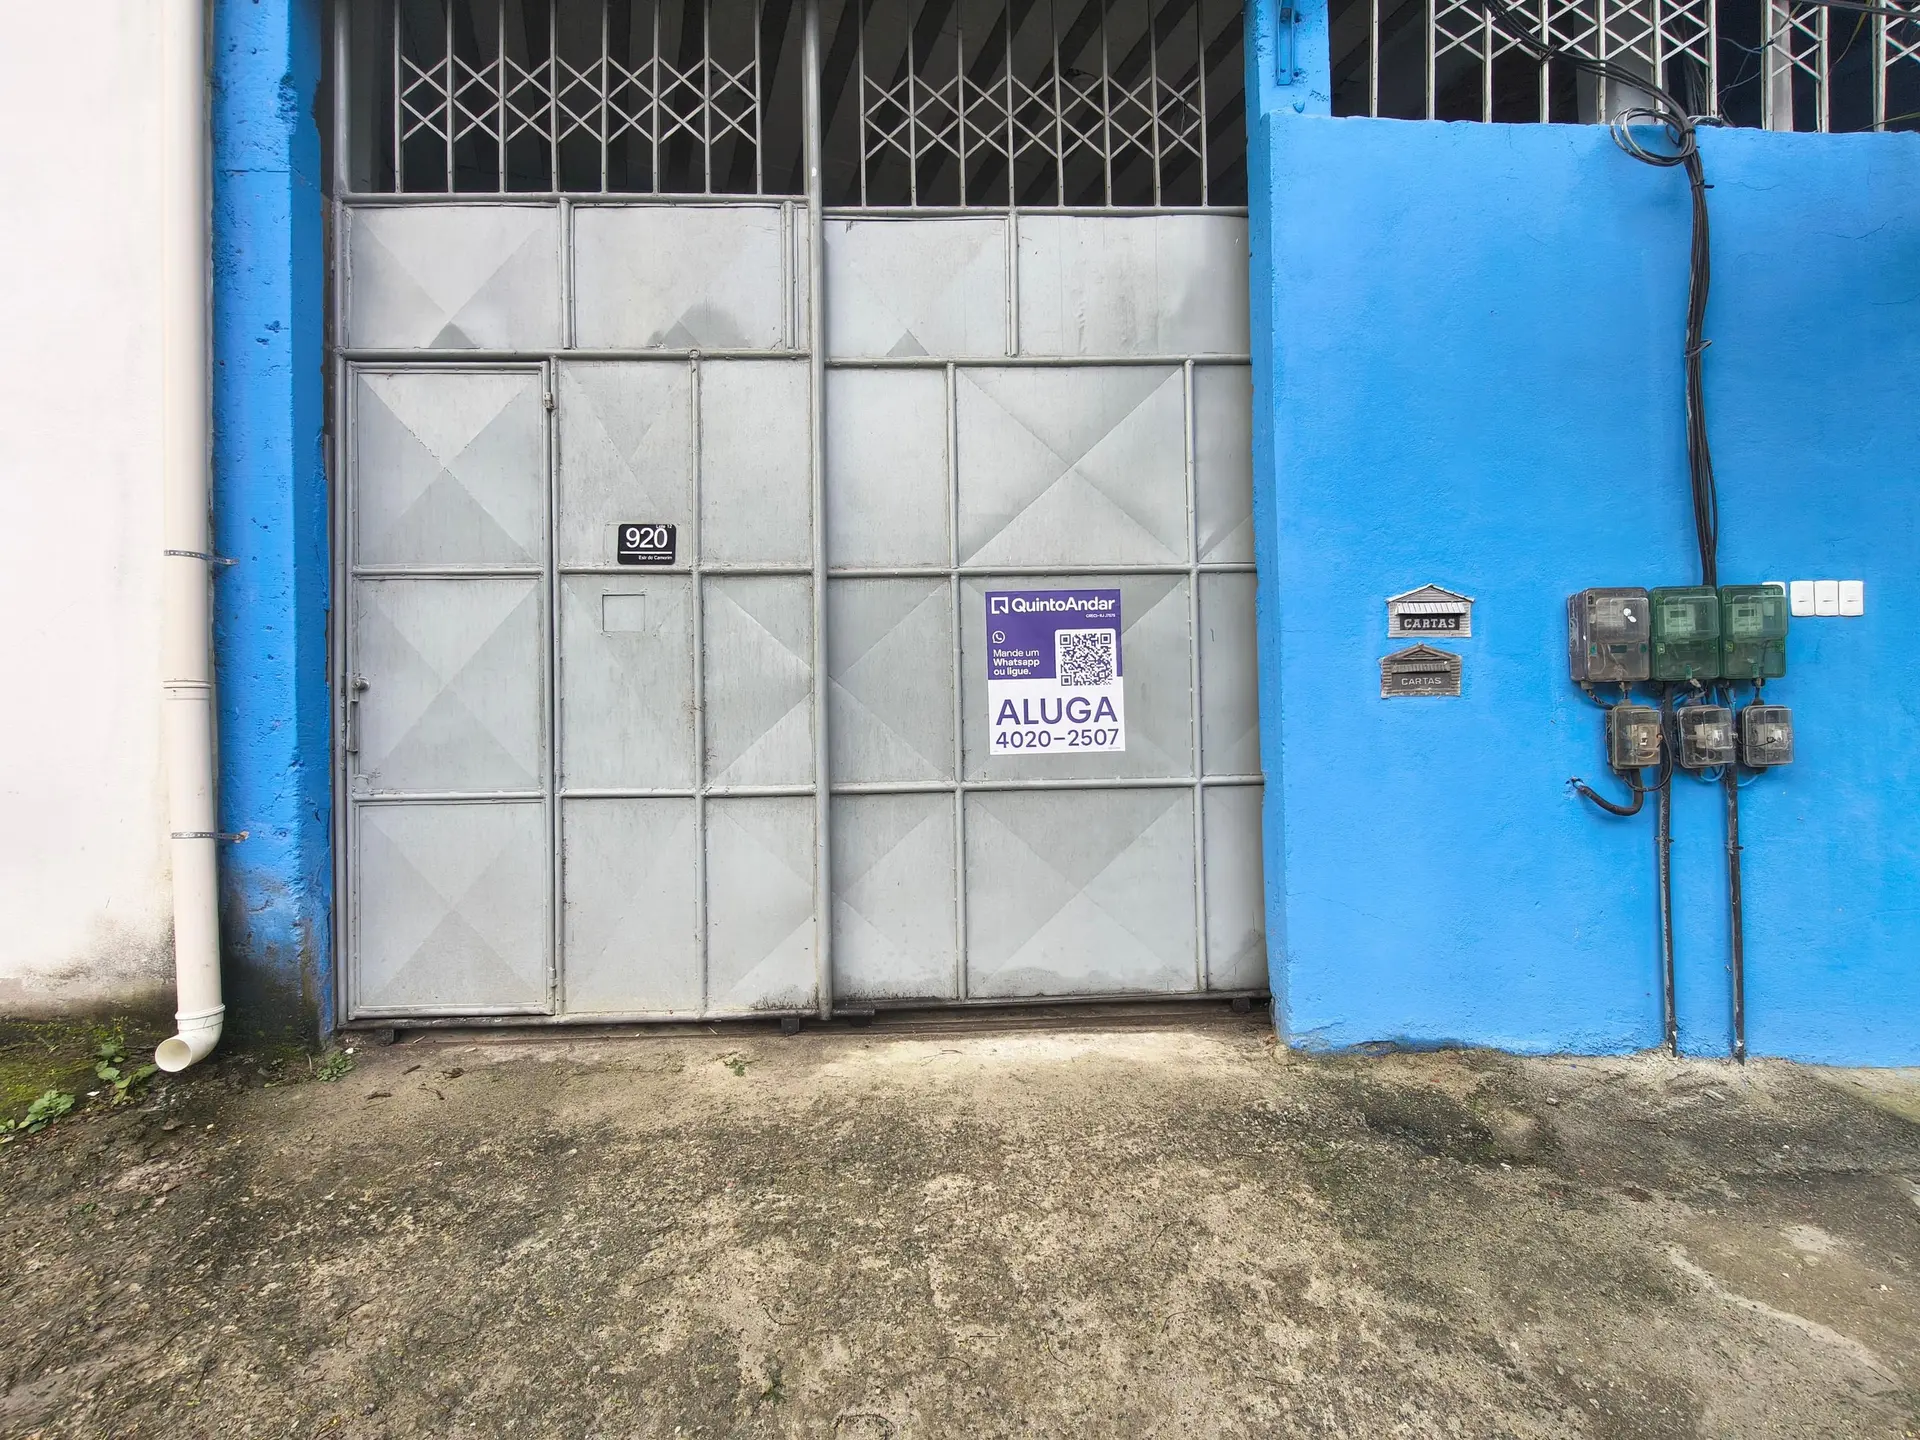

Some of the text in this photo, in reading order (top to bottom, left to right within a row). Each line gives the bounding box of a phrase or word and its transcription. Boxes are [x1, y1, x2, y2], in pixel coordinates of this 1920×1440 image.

[625, 527, 668, 548] 920
[1011, 596, 1116, 613] QuintoAndar
[1403, 618, 1456, 628] CARTAS
[992, 649, 1024, 657] Mande
[993, 658, 1040, 668] Whatsapp
[1007, 667, 1032, 677] ligue.
[1401, 677, 1442, 686] CARTAS
[995, 696, 1118, 726] ALUGA
[995, 728, 1119, 748] 4020-2507
